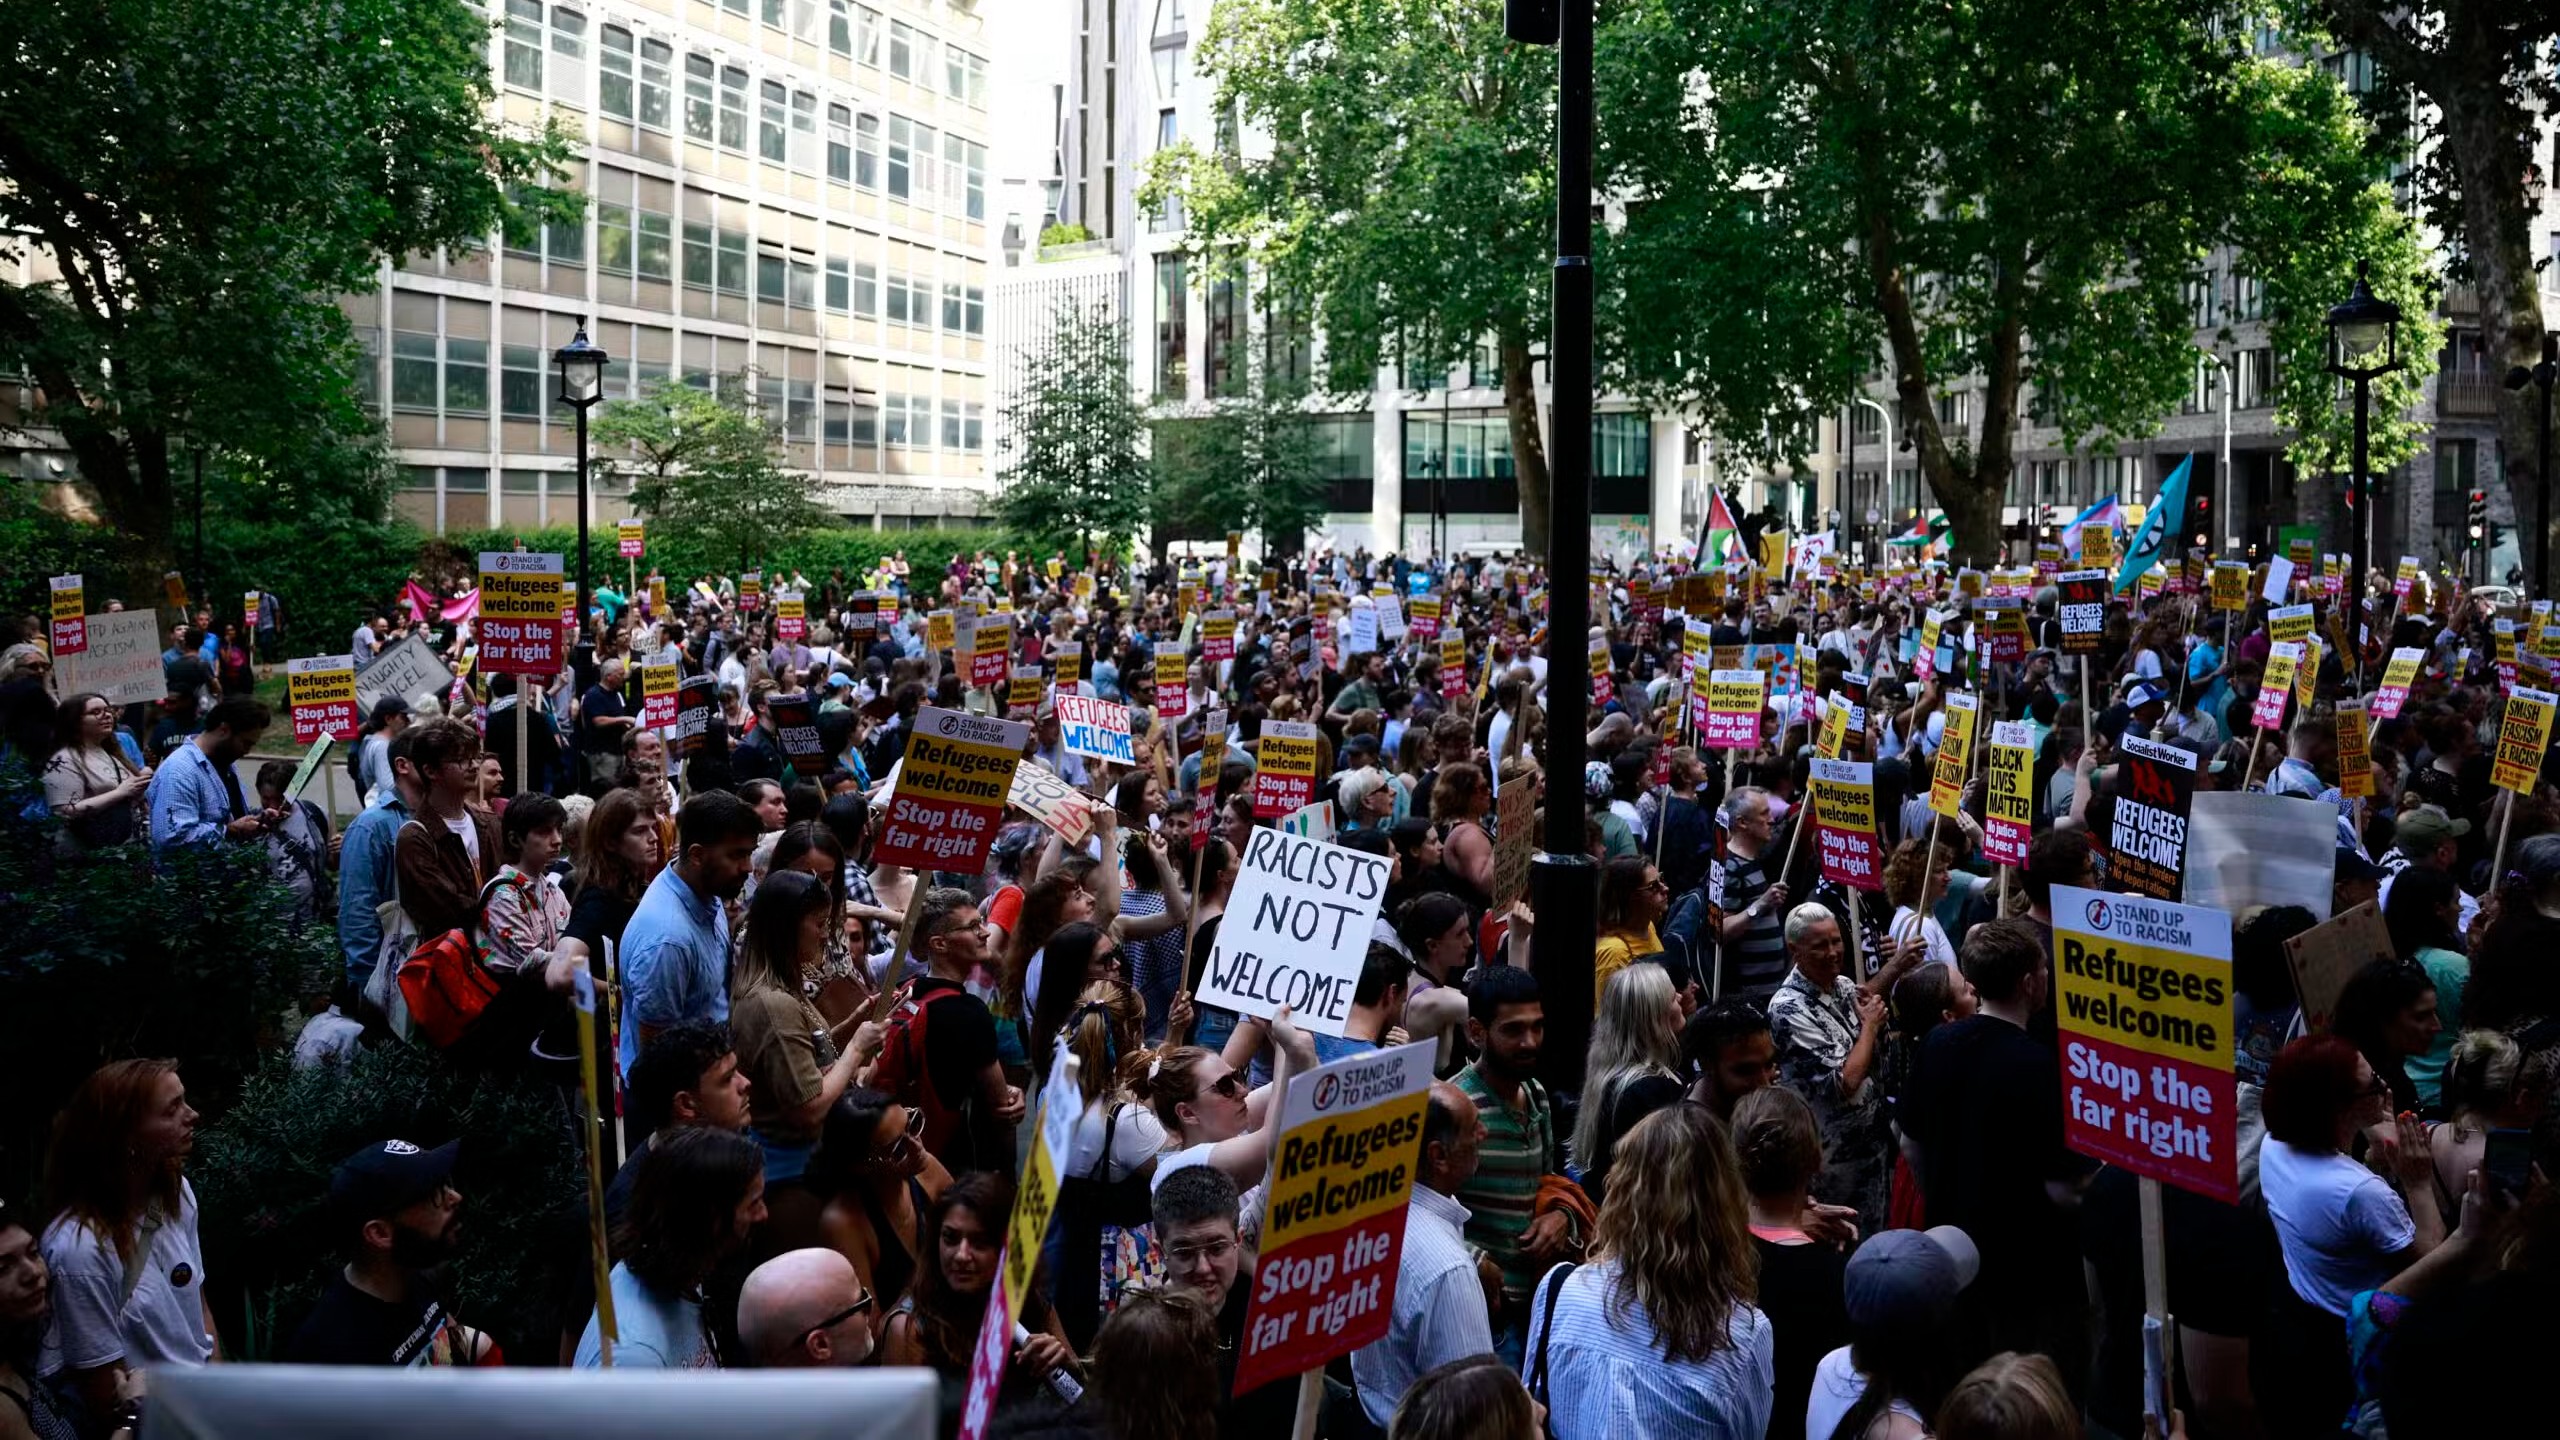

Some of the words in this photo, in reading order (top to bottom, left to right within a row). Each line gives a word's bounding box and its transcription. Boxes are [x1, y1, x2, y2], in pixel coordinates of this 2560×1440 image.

[511, 556, 532, 564] STAND
[511, 563, 520, 571] TO
[521, 563, 547, 571] RACISM
[484, 576, 559, 596] Refugees
[484, 596, 555, 613] welcome
[2060, 602, 2103, 620] REFUGEES
[483, 622, 520, 642] Stop
[524, 622, 552, 639] the
[2060, 617, 2103, 634] WELCOME
[2271, 618, 2313, 630] Refugees
[483, 642, 507, 659] far
[511, 643, 551, 663] right
[292, 673, 352, 687] Refugees
[356, 644, 415, 697] NAUGHTY
[644, 669, 676, 680] Refugees
[294, 686, 350, 701] welcome
[645, 680, 675, 691] welcome
[1157, 686, 1172, 698] Stop
[1173, 685, 1184, 695] the
[1712, 685, 1760, 697] Refugees
[295, 705, 325, 721] Stop
[328, 704, 350, 717] the
[646, 697, 663, 709] Stop
[663, 695, 674, 706] the
[1711, 697, 1758, 709] welcome
[2507, 700, 2541, 722] SMASH
[646, 709, 658, 721] far
[659, 706, 675, 720] right
[677, 706, 709, 724] REFUGEES
[1057, 696, 1129, 733] REFUGEES
[1709, 714, 1734, 728] Stop
[1736, 715, 1755, 727] the
[296, 720, 315, 734] far
[318, 717, 350, 735] right
[959, 728, 971, 739] TO
[971, 730, 1005, 743] RACISM
[961, 719, 989, 732] STAND
[990, 723, 1004, 733] UP
[1708, 727, 1727, 739] far
[1727, 728, 1753, 741] right
[2502, 721, 2543, 745] FASCISM
[783, 741, 824, 755] WELCOME
[1062, 725, 1136, 761] WELCOME
[1262, 738, 1315, 758] Refugees
[2126, 738, 2158, 759] Socialist
[2157, 748, 2188, 767] Worker
[911, 738, 1014, 775] Refugees
[1261, 756, 1312, 771] welcome
[1991, 747, 2024, 772] BLACK
[2497, 744, 2506, 759] &
[2508, 744, 2543, 769] RACISM
[905, 769, 1000, 799] welcome
[1258, 775, 1287, 793] Stop
[1289, 776, 1309, 793] the
[1991, 773, 2017, 794] LIVES
[1257, 792, 1275, 806] far
[1277, 794, 1307, 810] right
[1815, 782, 1870, 807] Refugees
[893, 799, 946, 831] Stop
[950, 808, 987, 832] the
[1818, 804, 1869, 826] welcome
[1988, 792, 2030, 821] MATTER
[1986, 819, 1996, 833] No
[2114, 795, 2185, 845] REFUGEES
[885, 825, 921, 849] far
[923, 832, 977, 859] right
[1820, 829, 1846, 850] Stop
[1847, 834, 1870, 854] the
[1985, 835, 1995, 849] No
[2111, 821, 2182, 873] WELCOME
[1247, 830, 1388, 900] RACISTS
[1823, 850, 1840, 868] far
[1841, 854, 1871, 876] right
[2114, 853, 2132, 870] Open
[2112, 866, 2122, 882] No
[1253, 892, 1364, 951] NOT
[2114, 903, 2160, 924] STAND
[2163, 910, 2184, 927] UP
[2115, 920, 2133, 936] TO
[2136, 924, 2192, 947] RACISM
[2062, 938, 2225, 1006] Refugees
[1211, 946, 1353, 1021] WELCOME
[2065, 990, 2217, 1051] welcome
[1343, 1065, 1384, 1087] STAND
[1385, 1058, 1403, 1079] UP
[2067, 1041, 2141, 1103] Stop
[2149, 1065, 2213, 1115] the
[1342, 1085, 1358, 1107] TO
[1362, 1075, 1406, 1103] RACISM
[2069, 1085, 2116, 1132] far
[2124, 1107, 2213, 1163] right
[1280, 1111, 1420, 1181] Refugees
[1273, 1163, 1406, 1232] welcome
[1258, 1252, 1334, 1305] Stop
[1342, 1229, 1391, 1276] the
[1249, 1310, 1299, 1357] far
[1305, 1272, 1381, 1337] right
